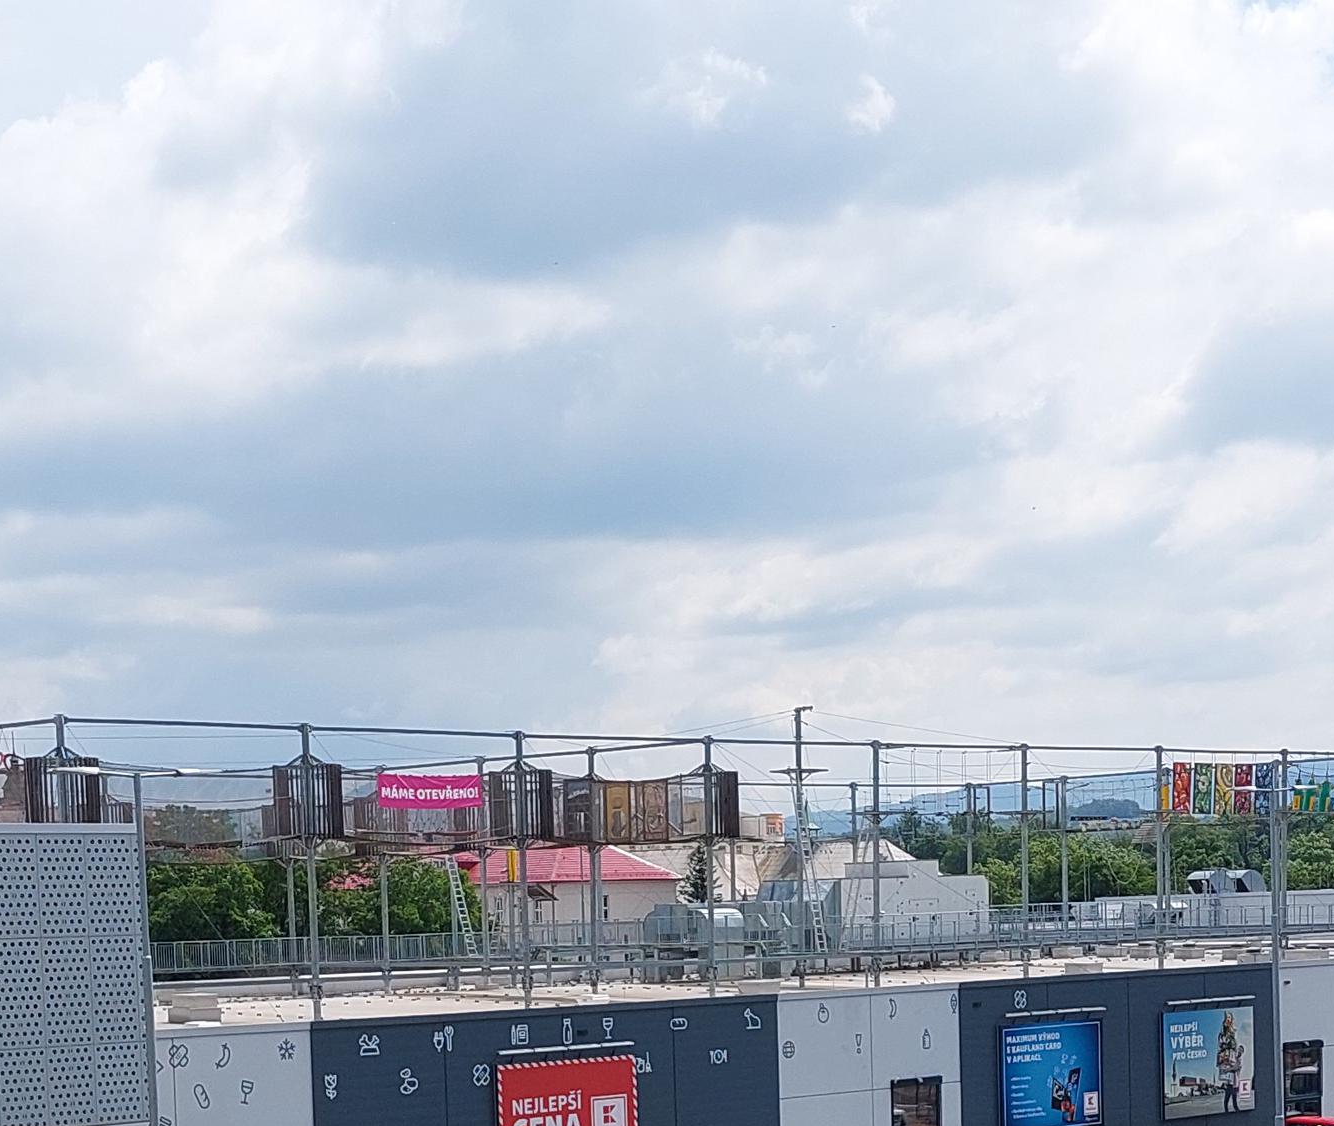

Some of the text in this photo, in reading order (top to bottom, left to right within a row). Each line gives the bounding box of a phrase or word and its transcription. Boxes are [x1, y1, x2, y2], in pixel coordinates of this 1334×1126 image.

[381, 784, 479, 800] MÁME OTEVŘENO!
[1170, 1032, 1204, 1049] VÝBĚR
[1172, 1049, 1208, 1061] PRO ČESKO
[512, 1089, 582, 1116] NEJLEPŠÍ
